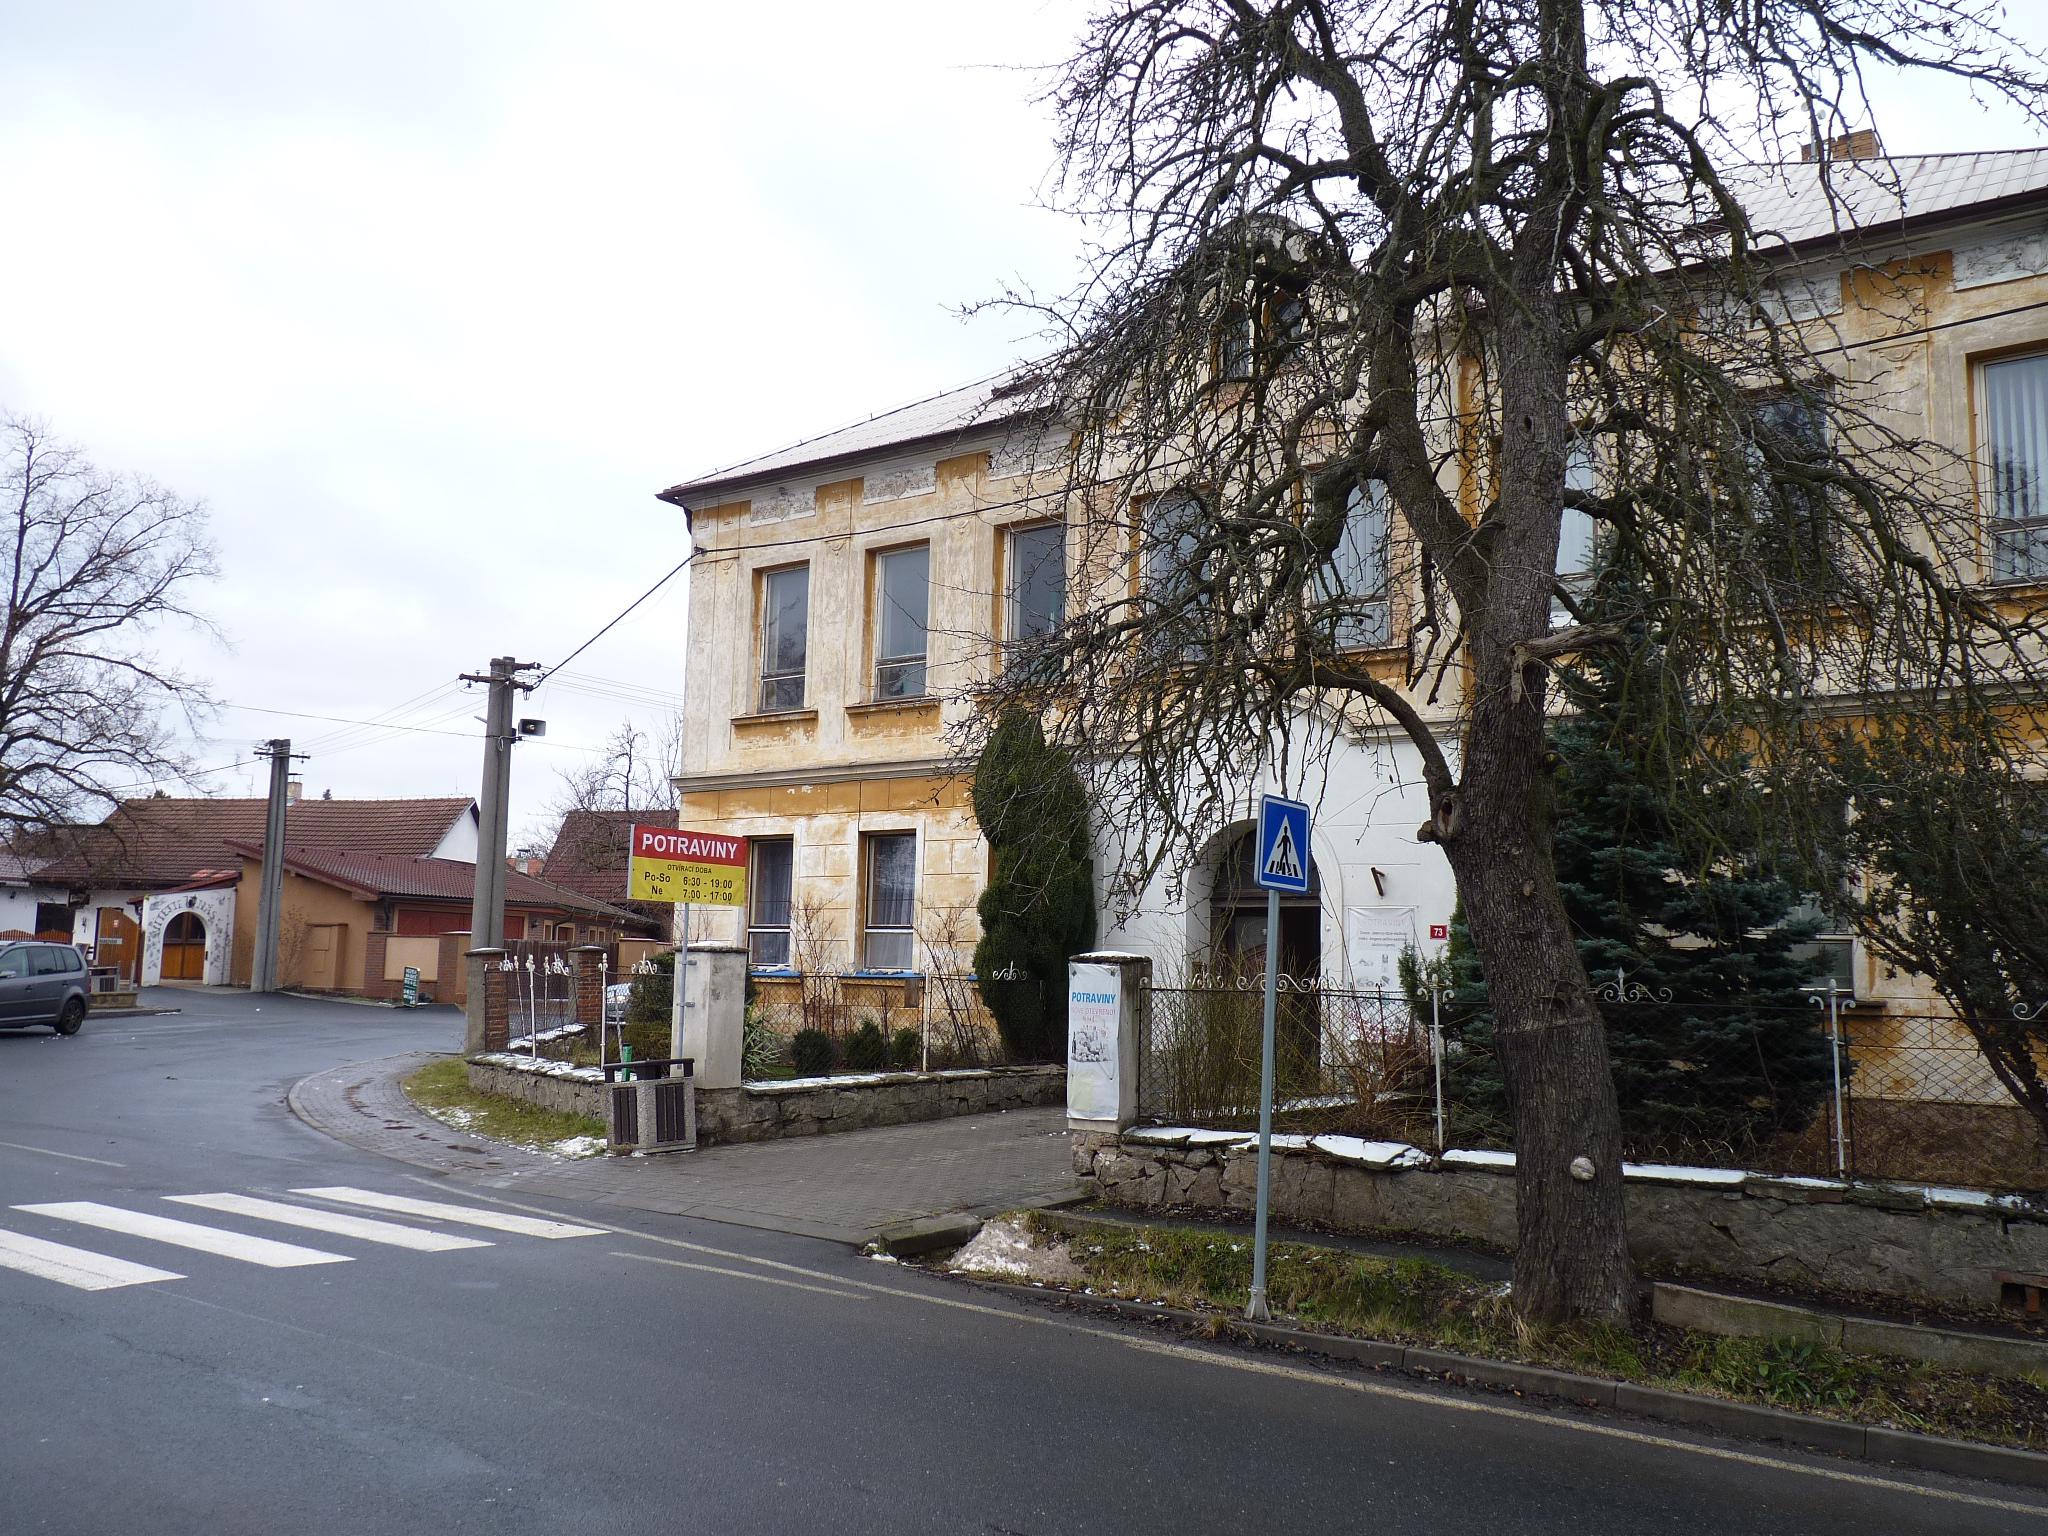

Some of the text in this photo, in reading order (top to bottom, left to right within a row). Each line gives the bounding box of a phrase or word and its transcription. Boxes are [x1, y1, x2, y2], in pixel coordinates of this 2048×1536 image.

[641, 833, 738, 859] POTRAVINY
[667, 863, 712, 874] OTVÍRACÍ DOBA
[644, 871, 671, 883] Po-So
[683, 876, 701, 887] 6:30
[710, 879, 733, 889] 19:00
[651, 885, 663, 895] Ne
[683, 889, 701, 899] 7:00
[709, 891, 733, 901] 17:00
[1434, 927, 1443, 937] 73
[1071, 991, 1117, 1004] POTRAVINY
